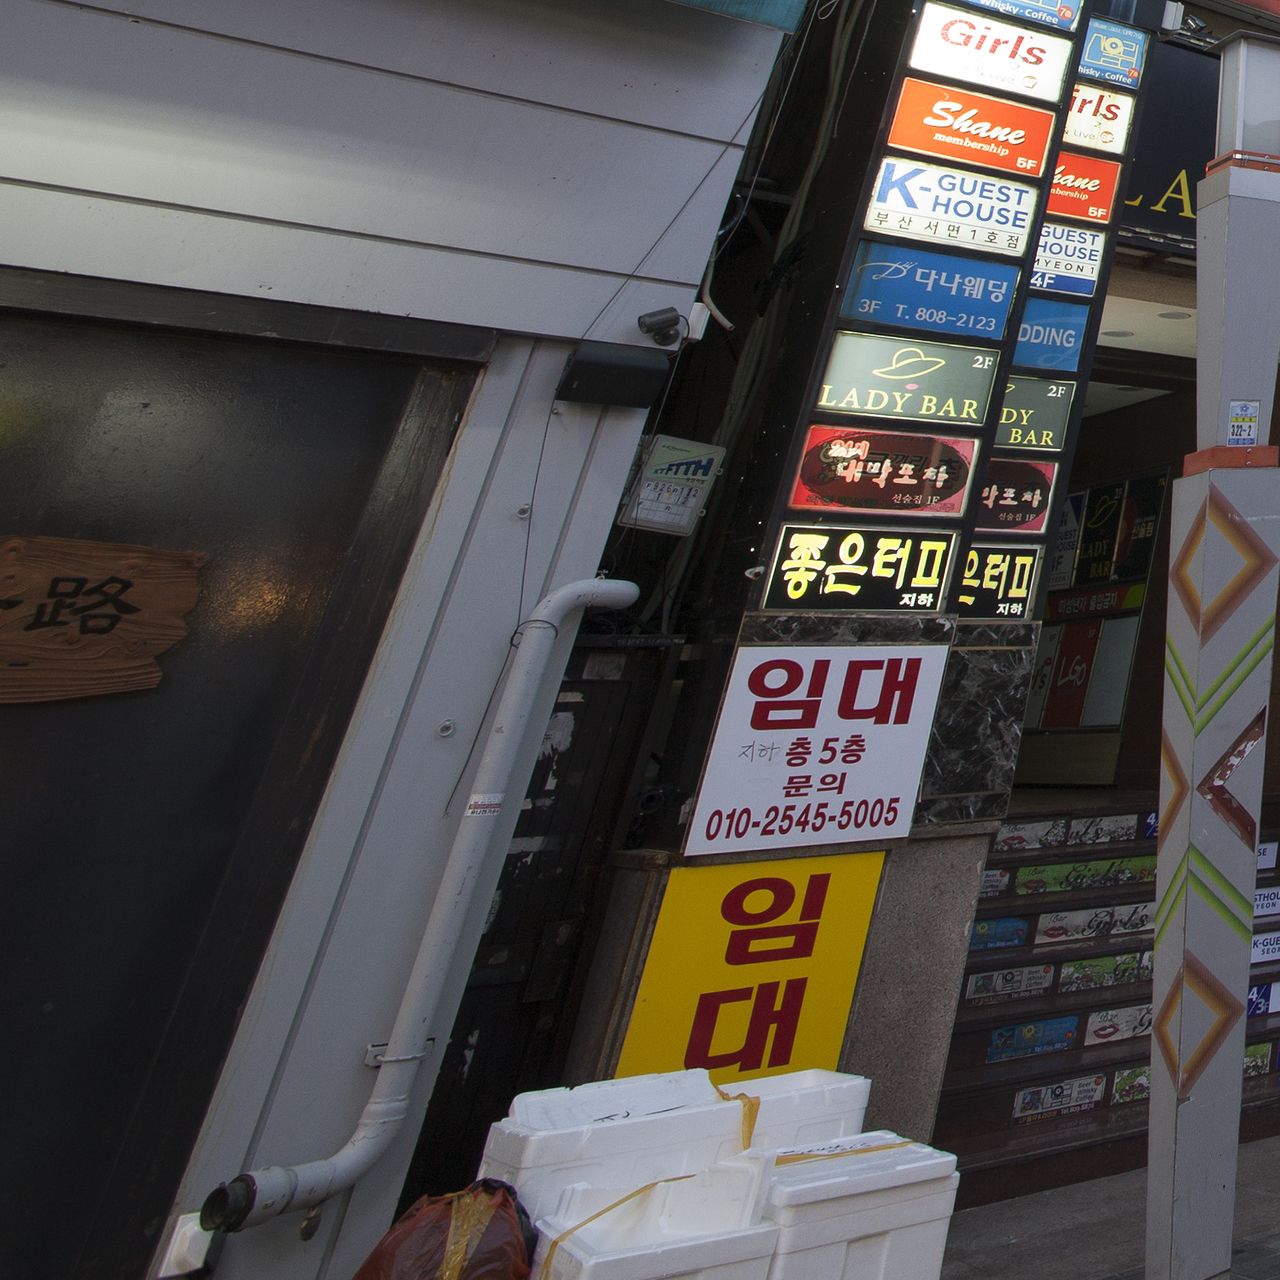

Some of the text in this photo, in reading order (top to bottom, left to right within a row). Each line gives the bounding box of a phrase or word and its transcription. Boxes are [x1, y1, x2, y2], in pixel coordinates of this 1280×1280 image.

[1024, 8, 1059, 25] Coffee
[1105, 72, 1132, 85] Coffee
[922, 99, 1026, 145] Shane
[932, 132, 1010, 157] membership
[1016, 157, 1038, 170] 5F
[938, 173, 1030, 206] GUEST
[931, 195, 1029, 229] HOUSE
[1088, 207, 1107, 218] 5F
[914, 267, 1008, 303] 다나웨딩
[1031, 272, 1056, 288] 4F
[858, 298, 996, 332] 3F 808-2123
[972, 355, 993, 370] 2F
[818, 383, 979, 420] LADY BAR
[1047, 385, 1066, 398] 2F
[1009, 427, 1054, 446] BAR
[900, 592, 934, 608] 지하
[996, 602, 1024, 616] 지하
[747, 657, 923, 731] 임대
[738, 740, 781, 762] 지하
[785, 734, 867, 768] 층 5층
[782, 772, 847, 798] 문의
[704, 797, 901, 841] 010-2545-5005
[683, 872, 832, 1073] 임대
